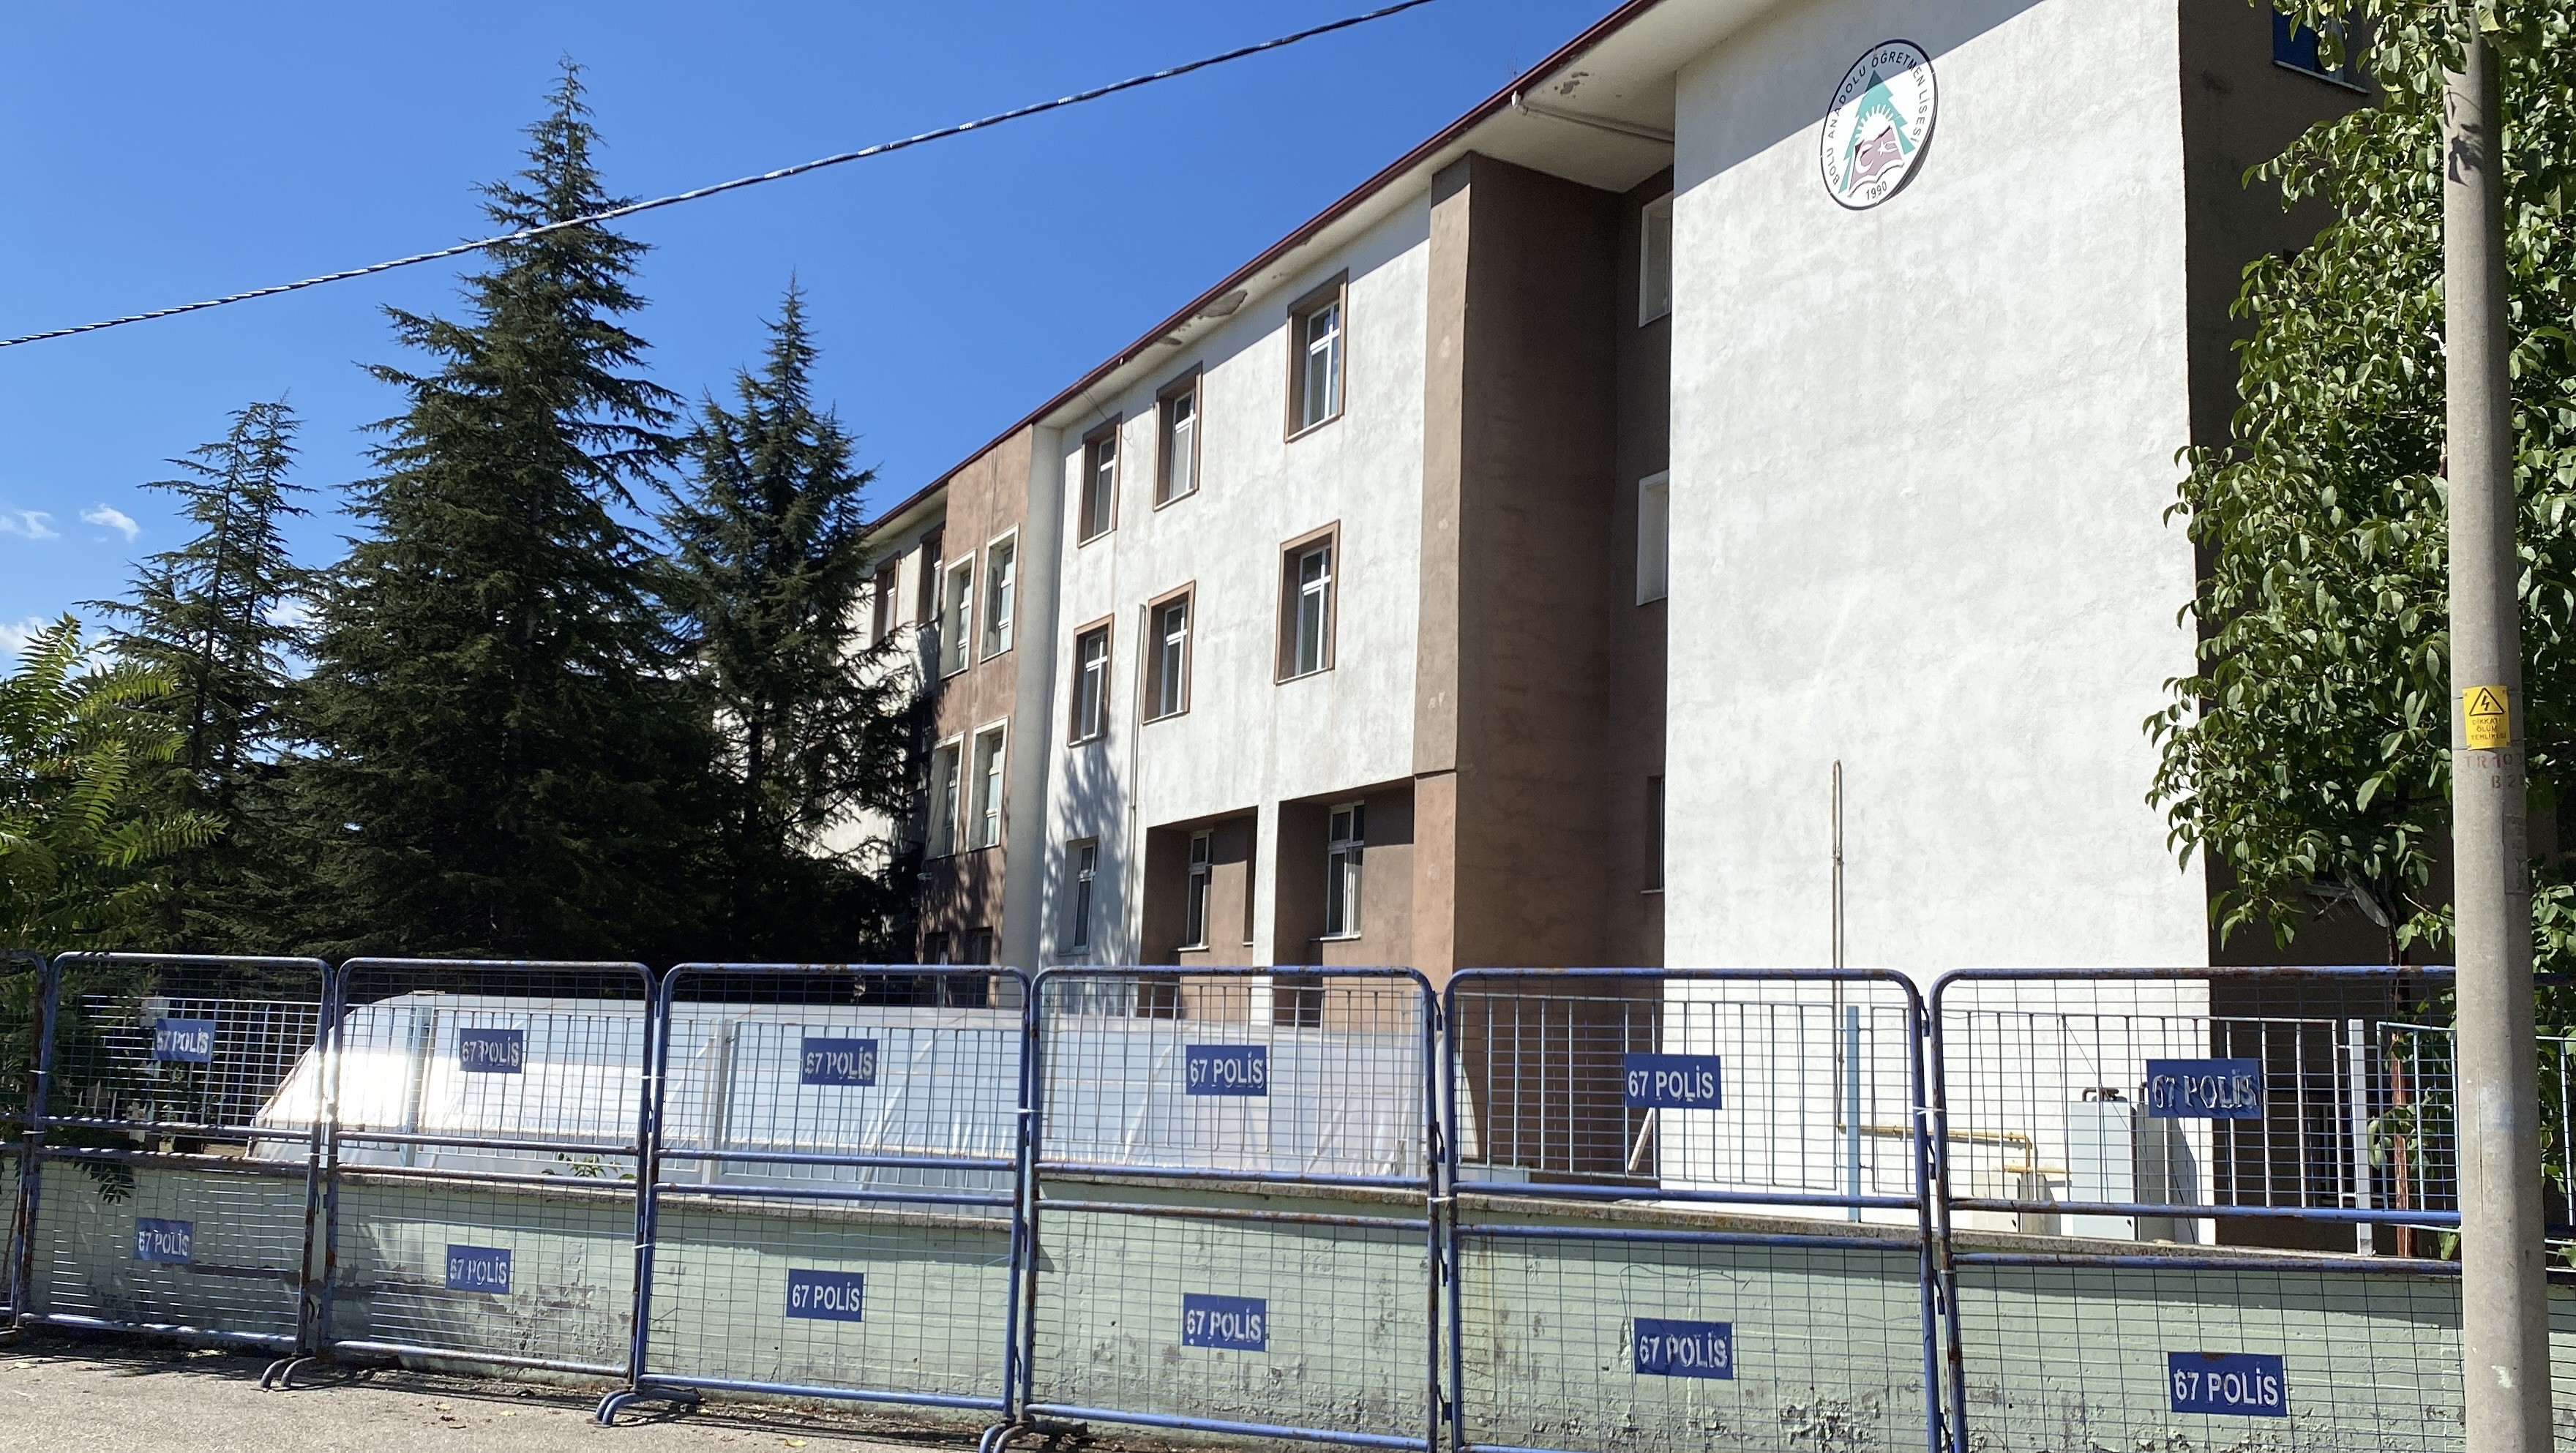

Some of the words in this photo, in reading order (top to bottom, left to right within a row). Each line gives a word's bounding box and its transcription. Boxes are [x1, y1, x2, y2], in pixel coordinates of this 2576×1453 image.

[1871, 50, 1926, 87] ÖĞRETMEN
[1828, 64, 1867, 139] ANADOLU
[1910, 89, 1931, 143] LİSESİ
[1827, 147, 1840, 185] BOLU
[1865, 181, 1887, 201] 1990
[172, 1024, 209, 1054] POLİS
[462, 1040, 476, 1062] 67
[479, 1037, 519, 1067] POLİS
[805, 1053, 822, 1075] 67
[826, 1046, 872, 1078] POLİS
[1190, 1059, 1208, 1086] 67
[1213, 1051, 1264, 1087] POLİS
[1628, 1071, 1648, 1097] 67
[1655, 1065, 1714, 1101] POLİS
[2183, 1069, 2257, 1110] POLİS
[154, 1228, 190, 1256] POLİS
[450, 1258, 464, 1280] 67
[468, 1253, 507, 1286] POLİS
[792, 1284, 808, 1307] 67
[814, 1281, 859, 1311] POLİS
[1187, 1310, 1205, 1335] 67
[1210, 1304, 1262, 1341] POLİS
[1639, 1336, 1660, 1364] 67
[1667, 1329, 1726, 1368] POLİS
[2174, 1373, 2199, 1400] 67
[2207, 1367, 2278, 1405] POLİS
